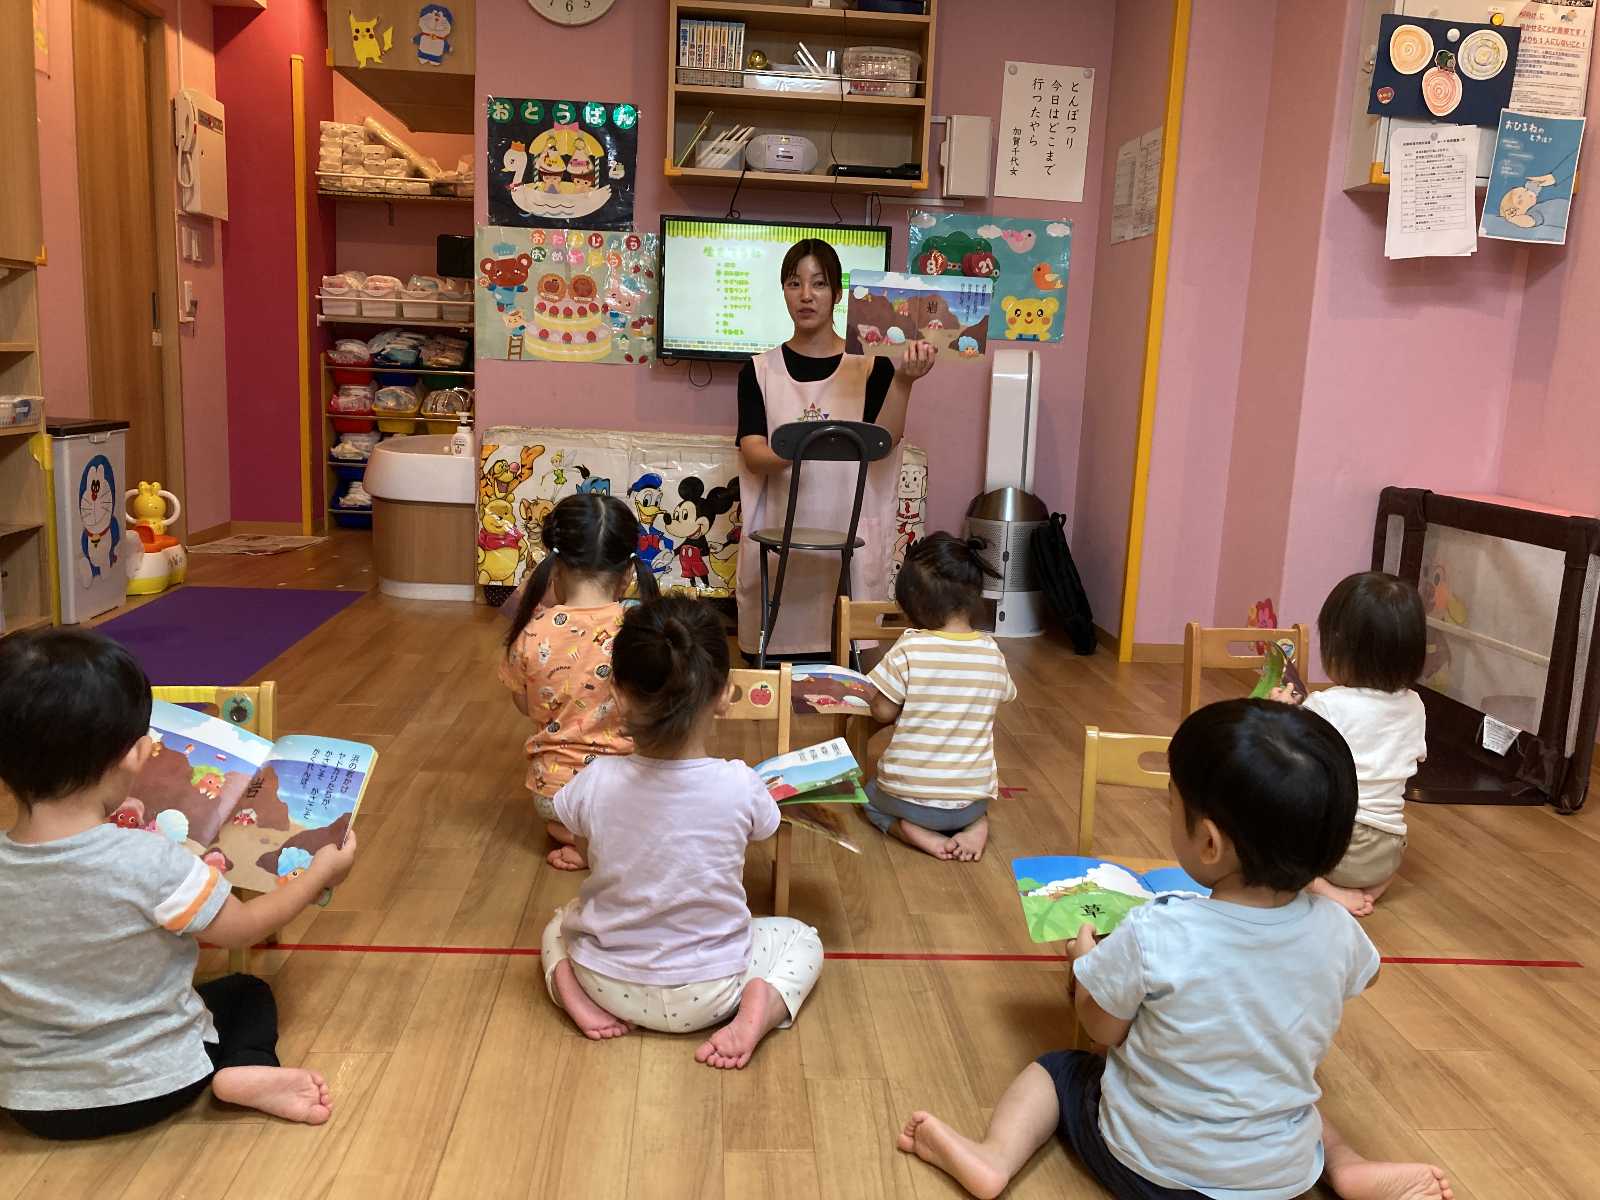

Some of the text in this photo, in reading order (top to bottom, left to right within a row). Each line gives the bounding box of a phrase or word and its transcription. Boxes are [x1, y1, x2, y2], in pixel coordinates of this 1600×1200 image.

[566, 0, 573, 12] 6
[492, 101, 634, 128] おとうばん
[1044, 80, 1062, 175] 今日はどこまで
[1066, 81, 1080, 149] とんぼつり
[1505, 120, 1545, 134] おひるねの
[1009, 127, 1021, 176] 加賀千代女
[979, 258, 994, 273] 21
